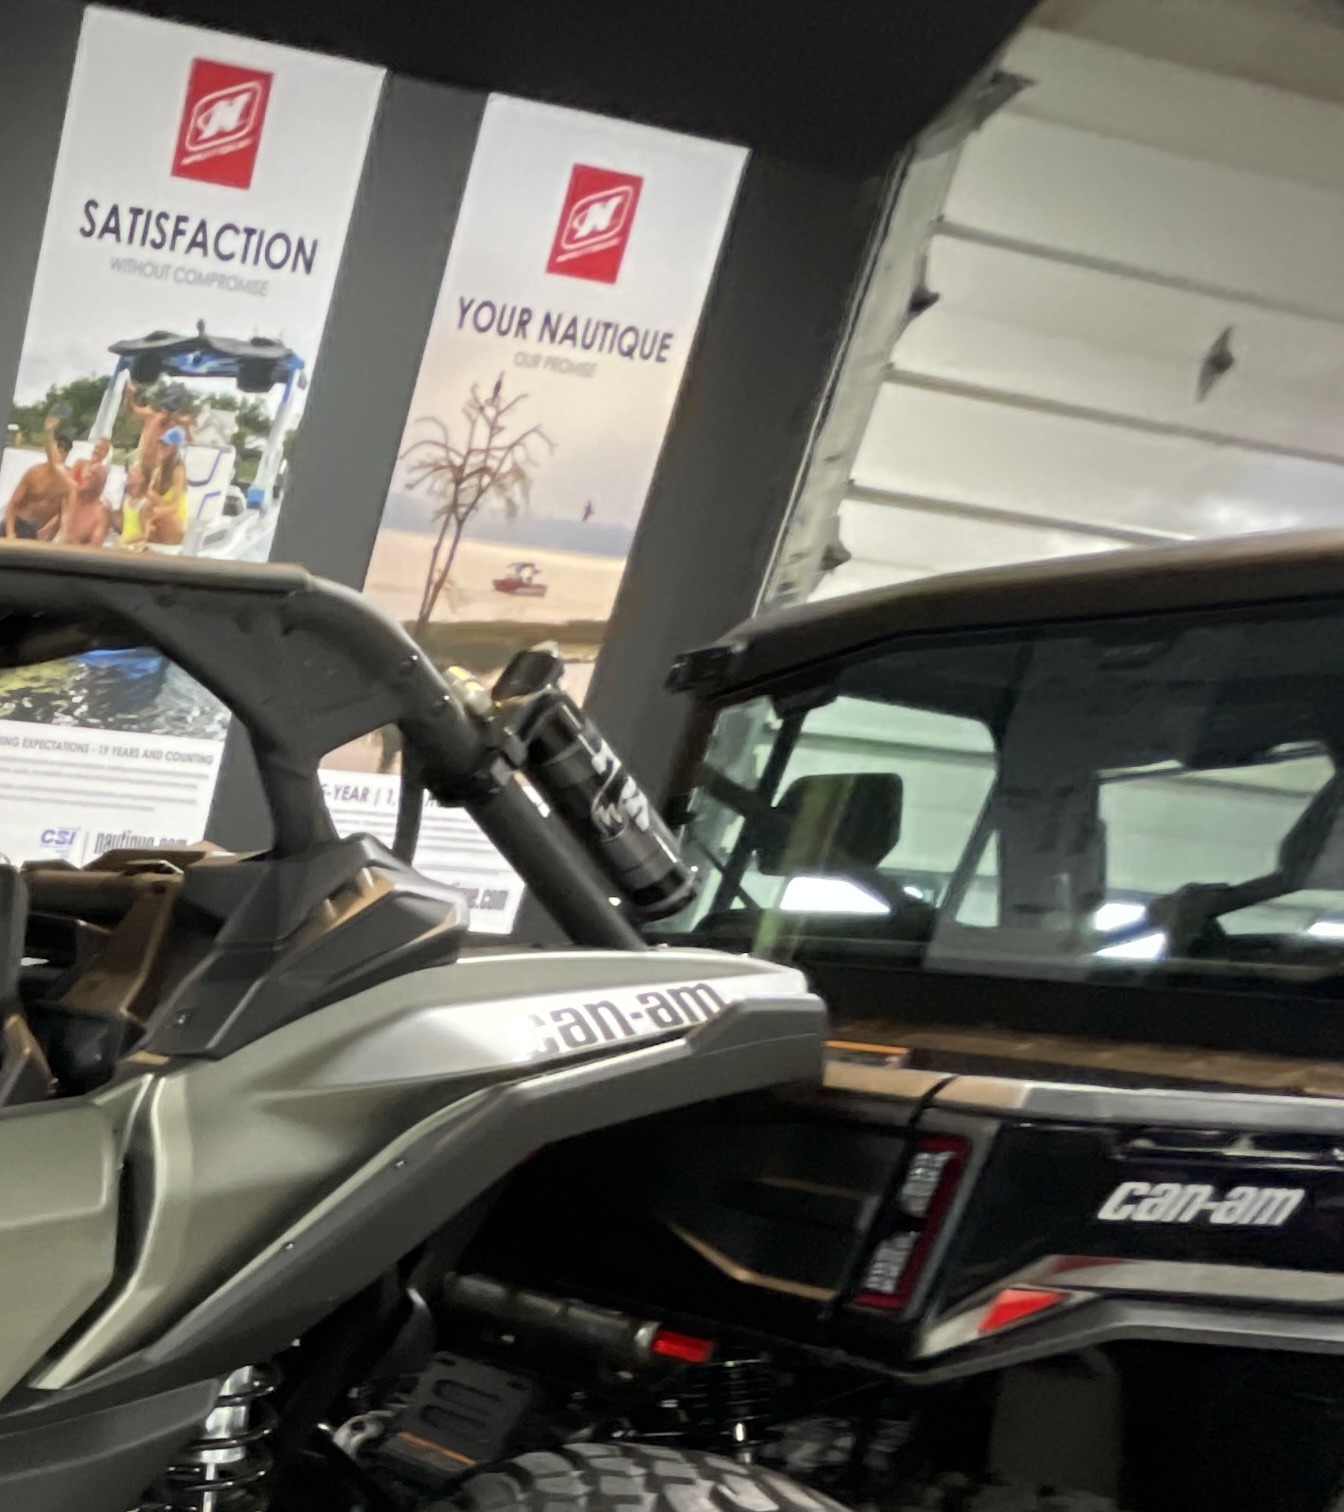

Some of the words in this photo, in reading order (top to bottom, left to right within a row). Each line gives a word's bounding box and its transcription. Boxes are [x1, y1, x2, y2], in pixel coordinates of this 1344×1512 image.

[79, 199, 319, 275] SATISFACTION
[109, 256, 170, 280] WITHOUT
[172, 265, 270, 297] COMPROMISE
[457, 296, 533, 340] YOUR
[538, 310, 675, 364] NAUTIQUE
[22, 739, 90, 754] EXPECTATIONS
[110, 745, 140, 759] YEARS
[141, 748, 164, 761] AND
[165, 750, 214, 766] COUNTING
[40, 828, 78, 846] CSI
[1097, 1180, 1306, 1226] can-am
